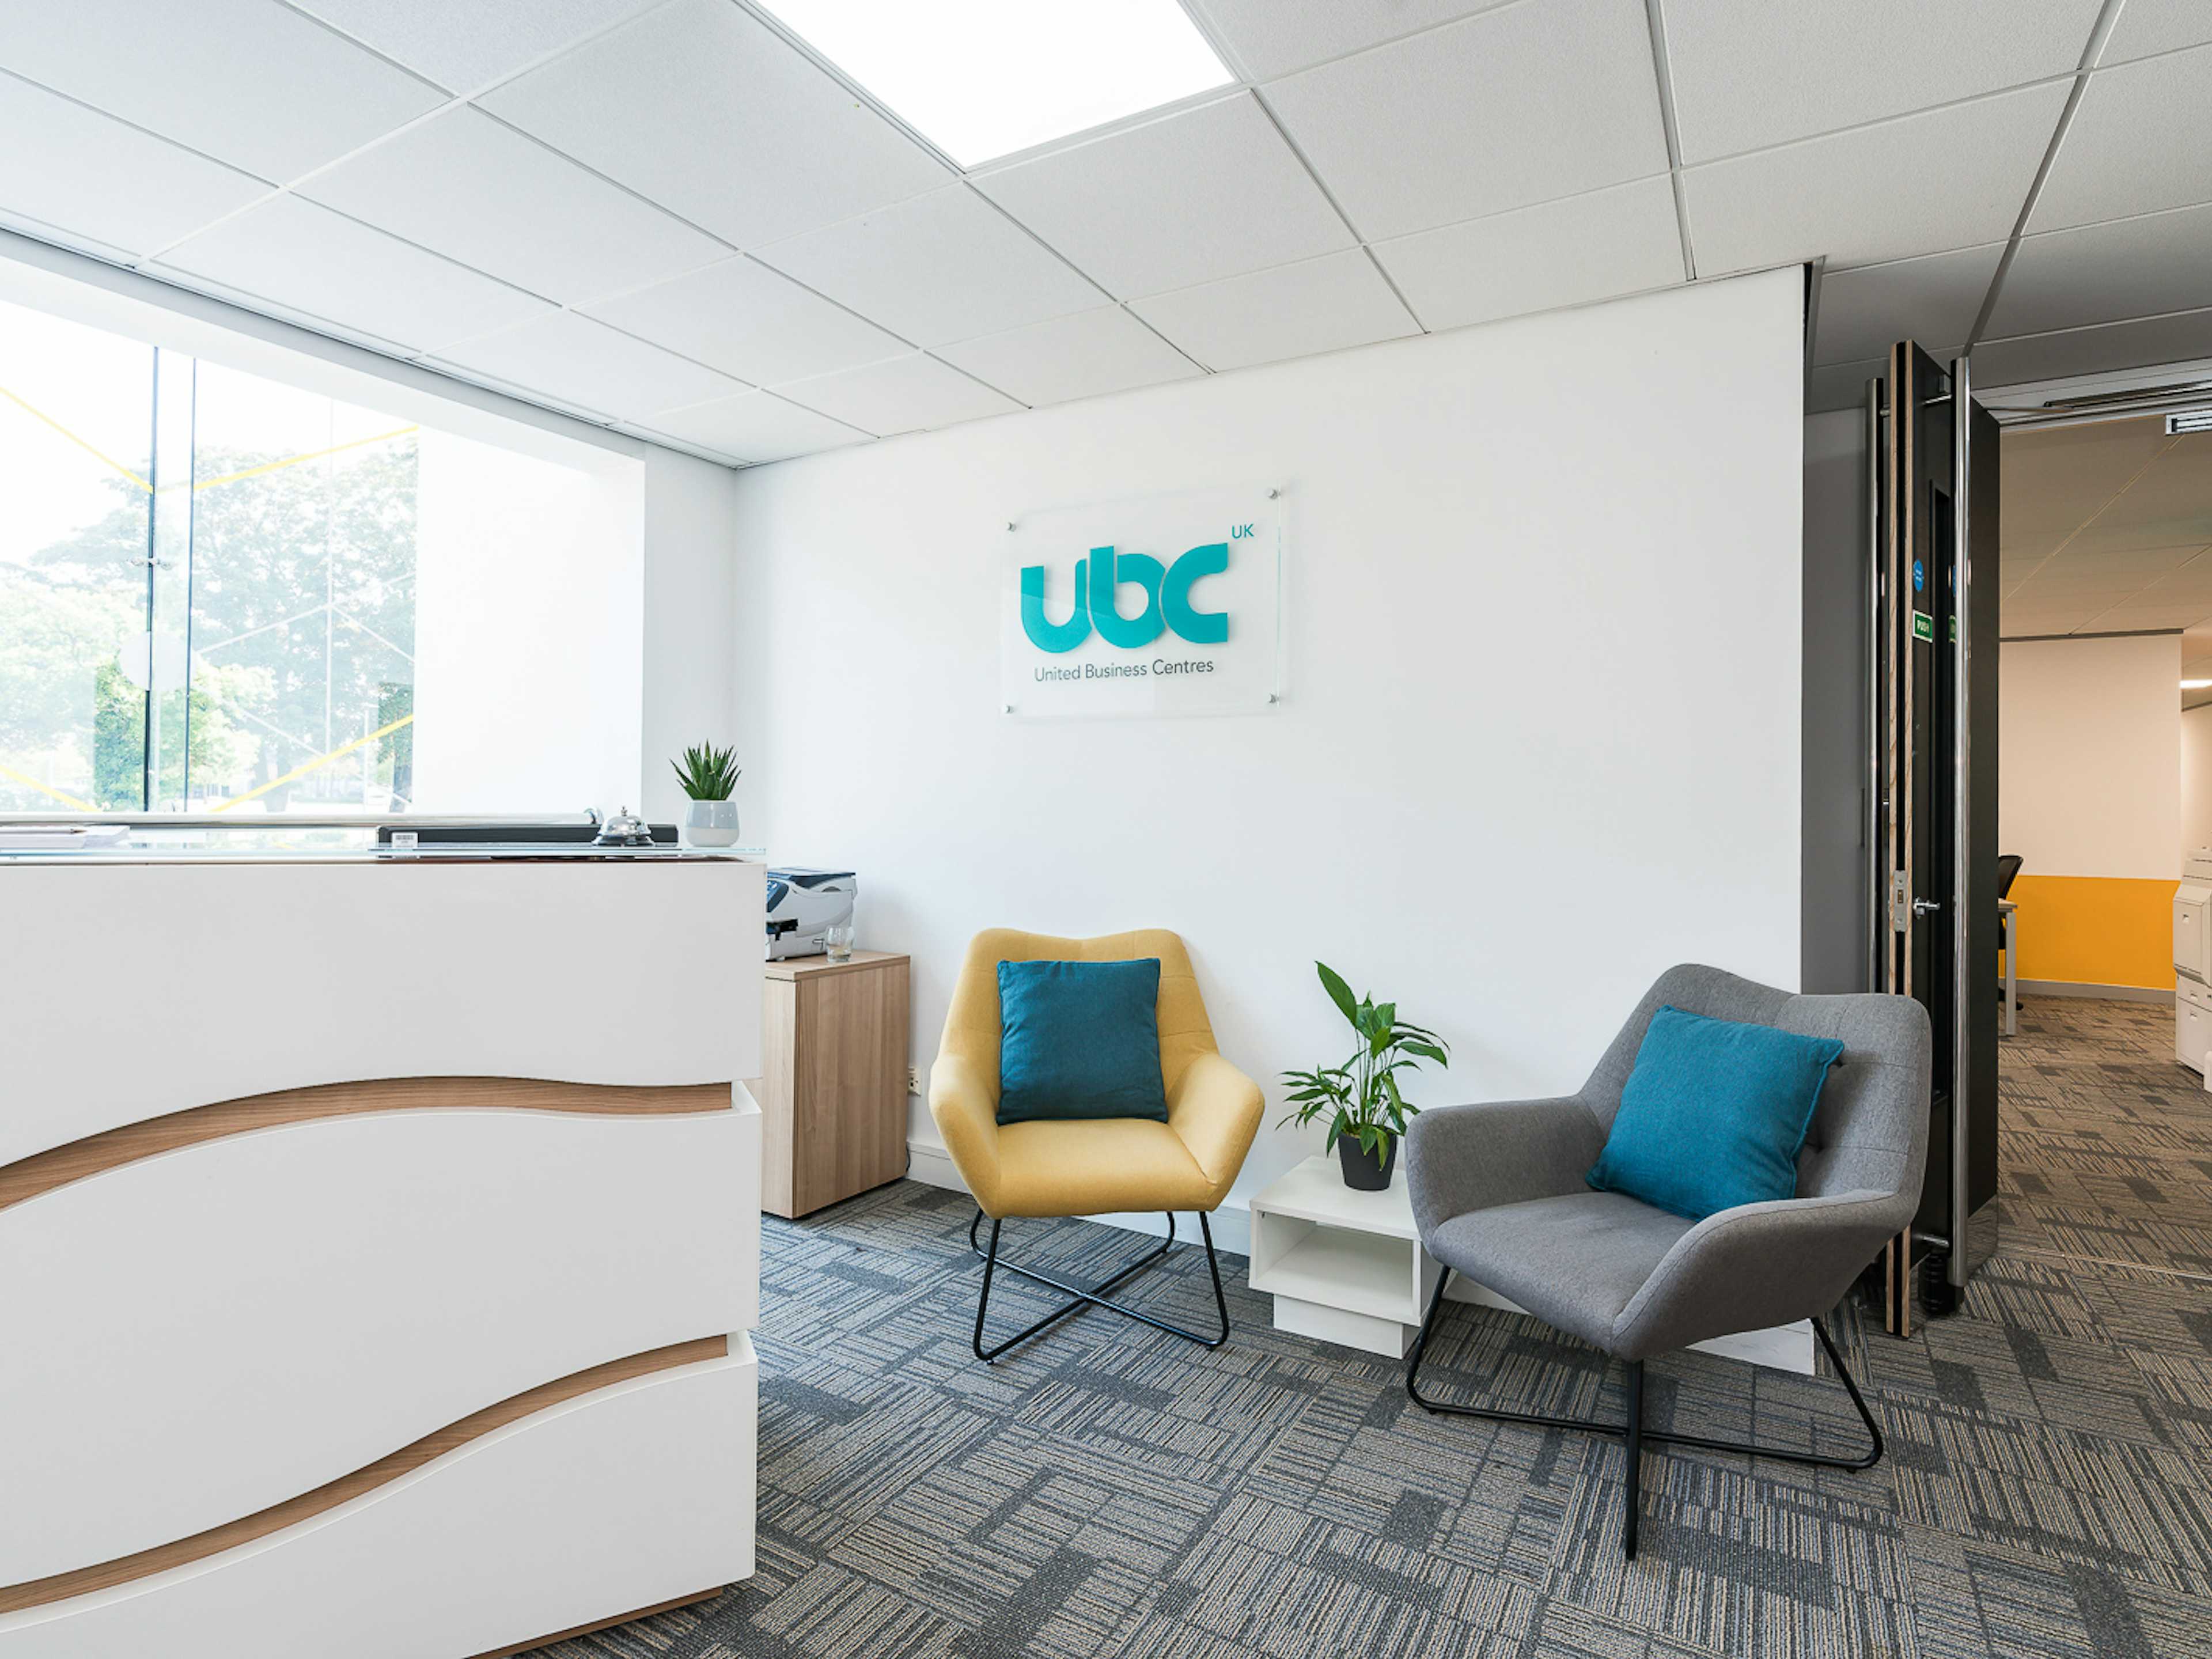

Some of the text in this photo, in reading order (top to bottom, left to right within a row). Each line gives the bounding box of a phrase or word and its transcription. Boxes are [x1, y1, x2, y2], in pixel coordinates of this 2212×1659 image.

[1232, 523, 1255, 539] UK
[1020, 542, 1228, 653] ubc
[1035, 659, 1214, 681] United Business Centres
